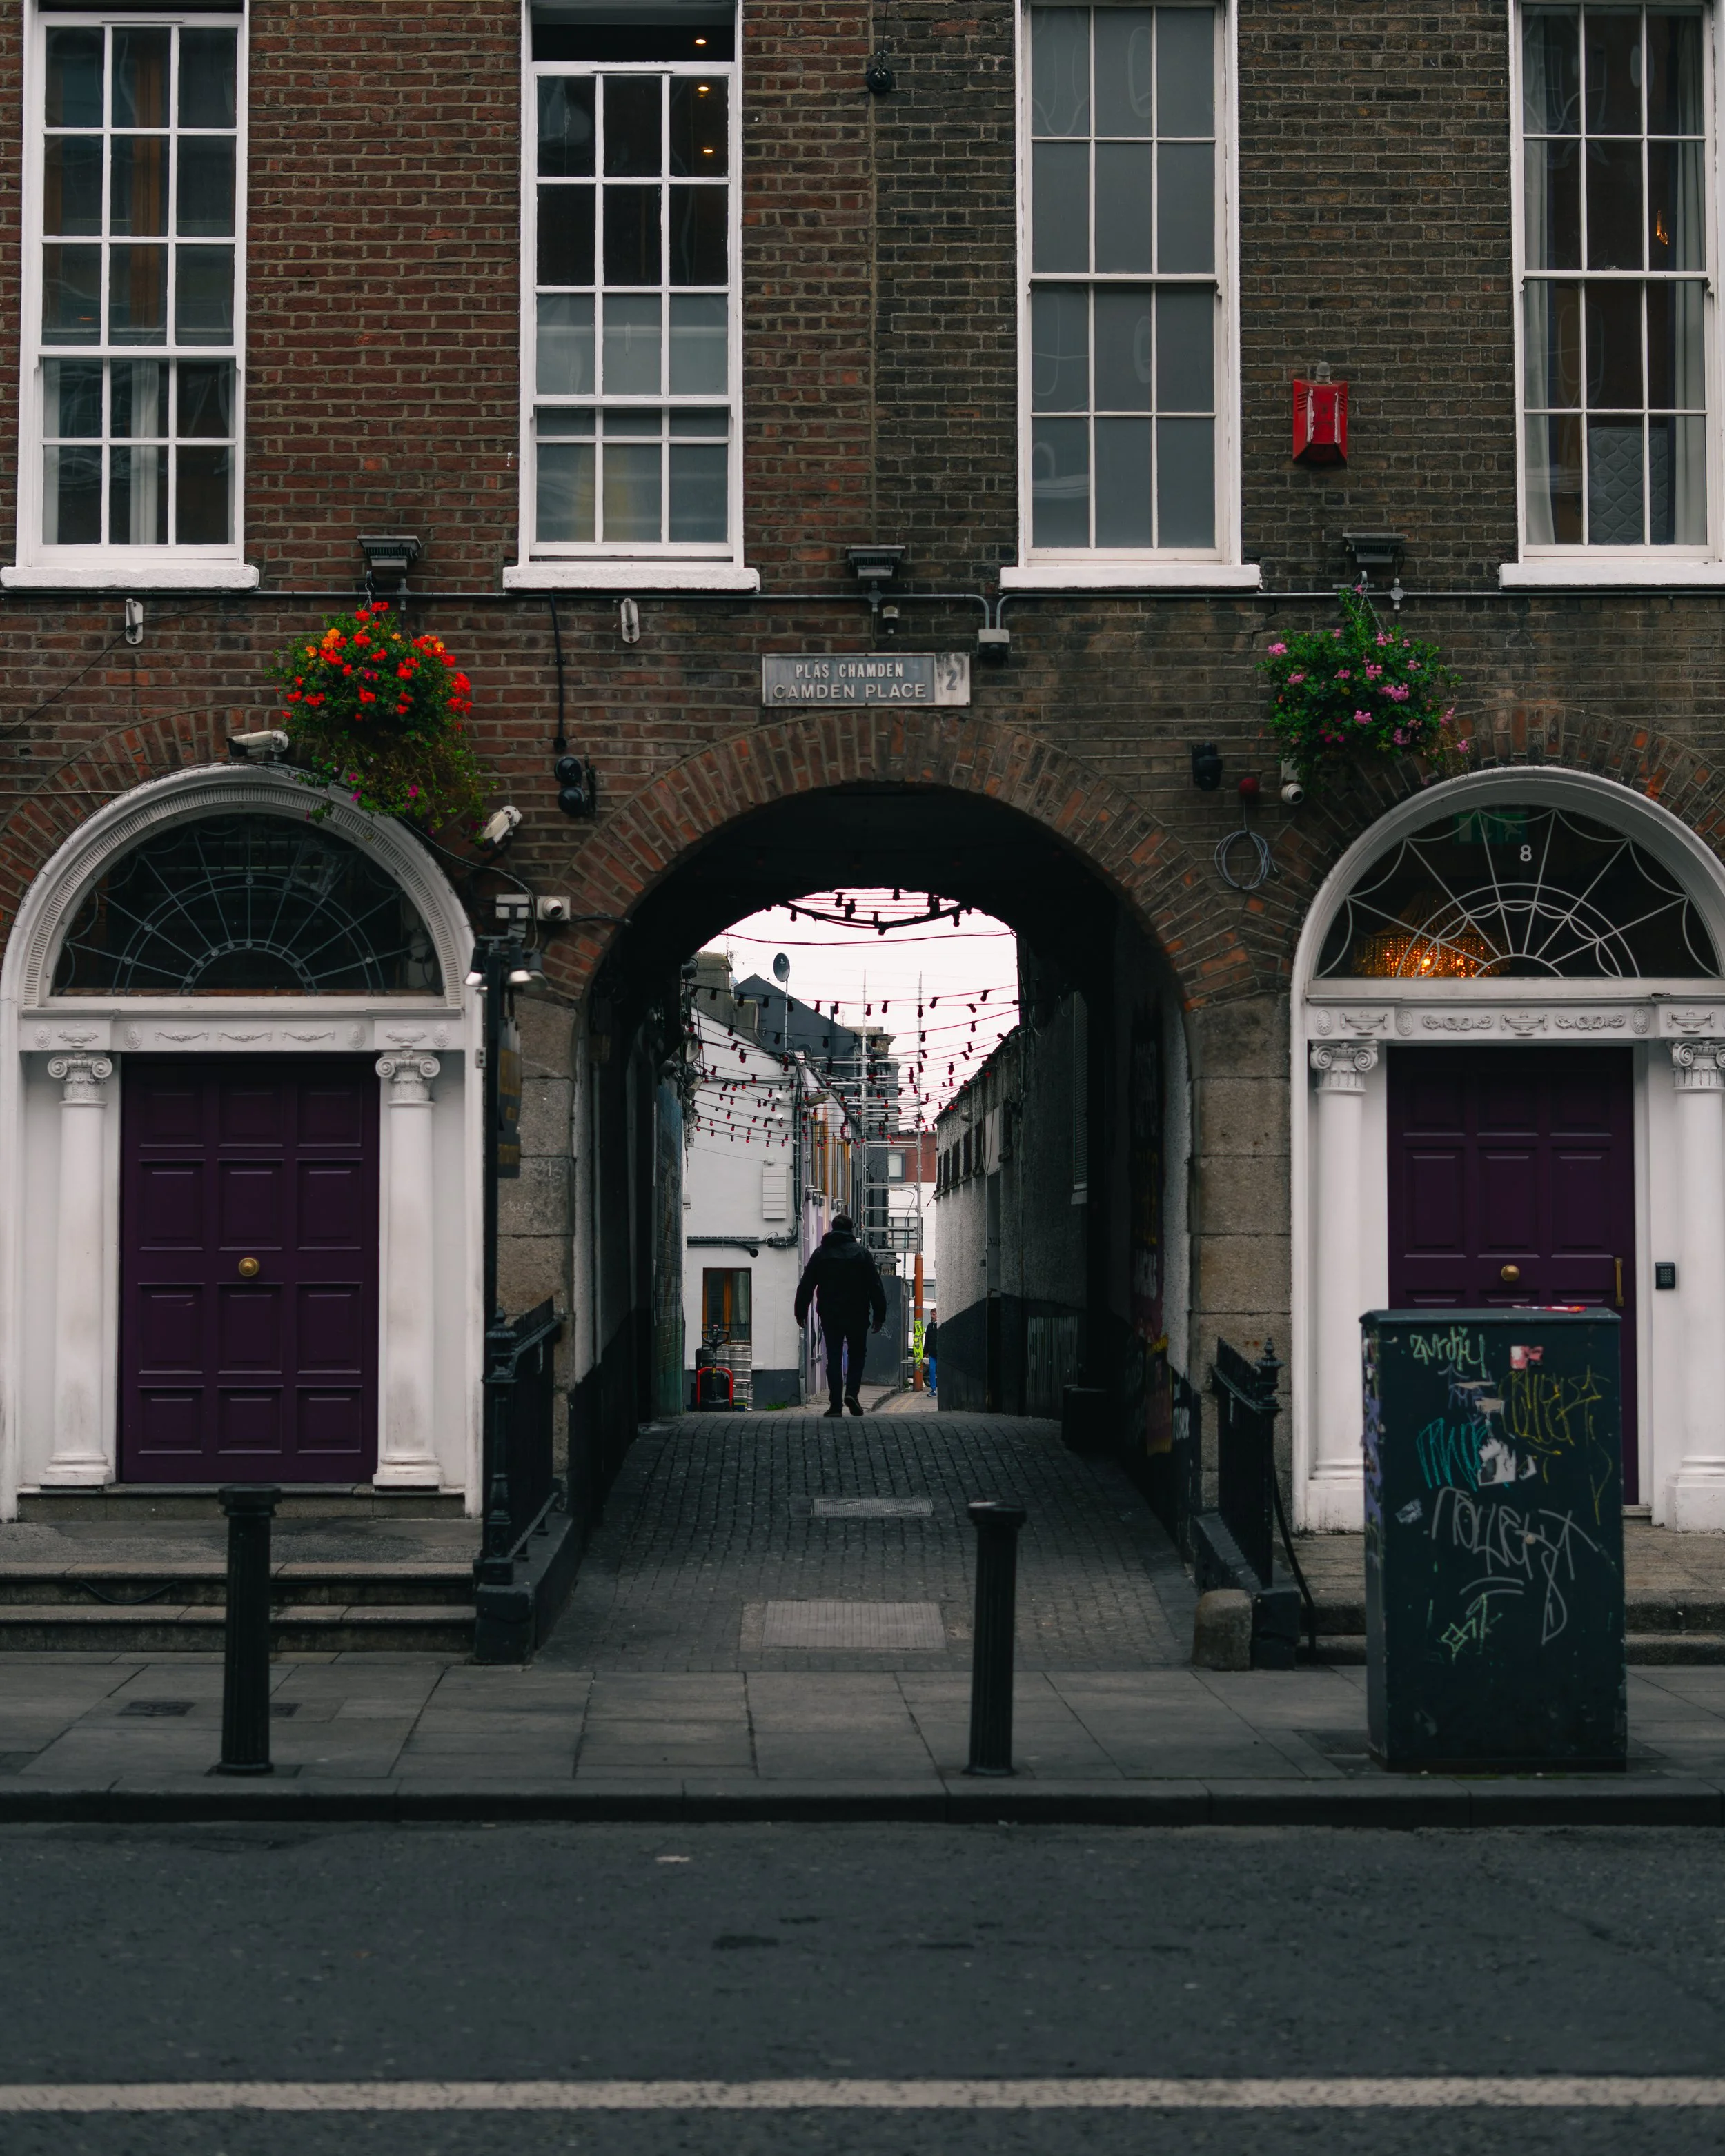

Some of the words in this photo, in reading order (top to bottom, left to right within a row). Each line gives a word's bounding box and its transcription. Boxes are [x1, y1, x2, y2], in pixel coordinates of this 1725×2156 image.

[796, 660, 829, 678] PLÁS
[838, 663, 904, 678] CHAMDEN
[946, 669, 957, 691] 2
[773, 683, 855, 699] CAMDEN
[865, 683, 927, 699] PLACE
[1519, 844, 1532, 862] 8
